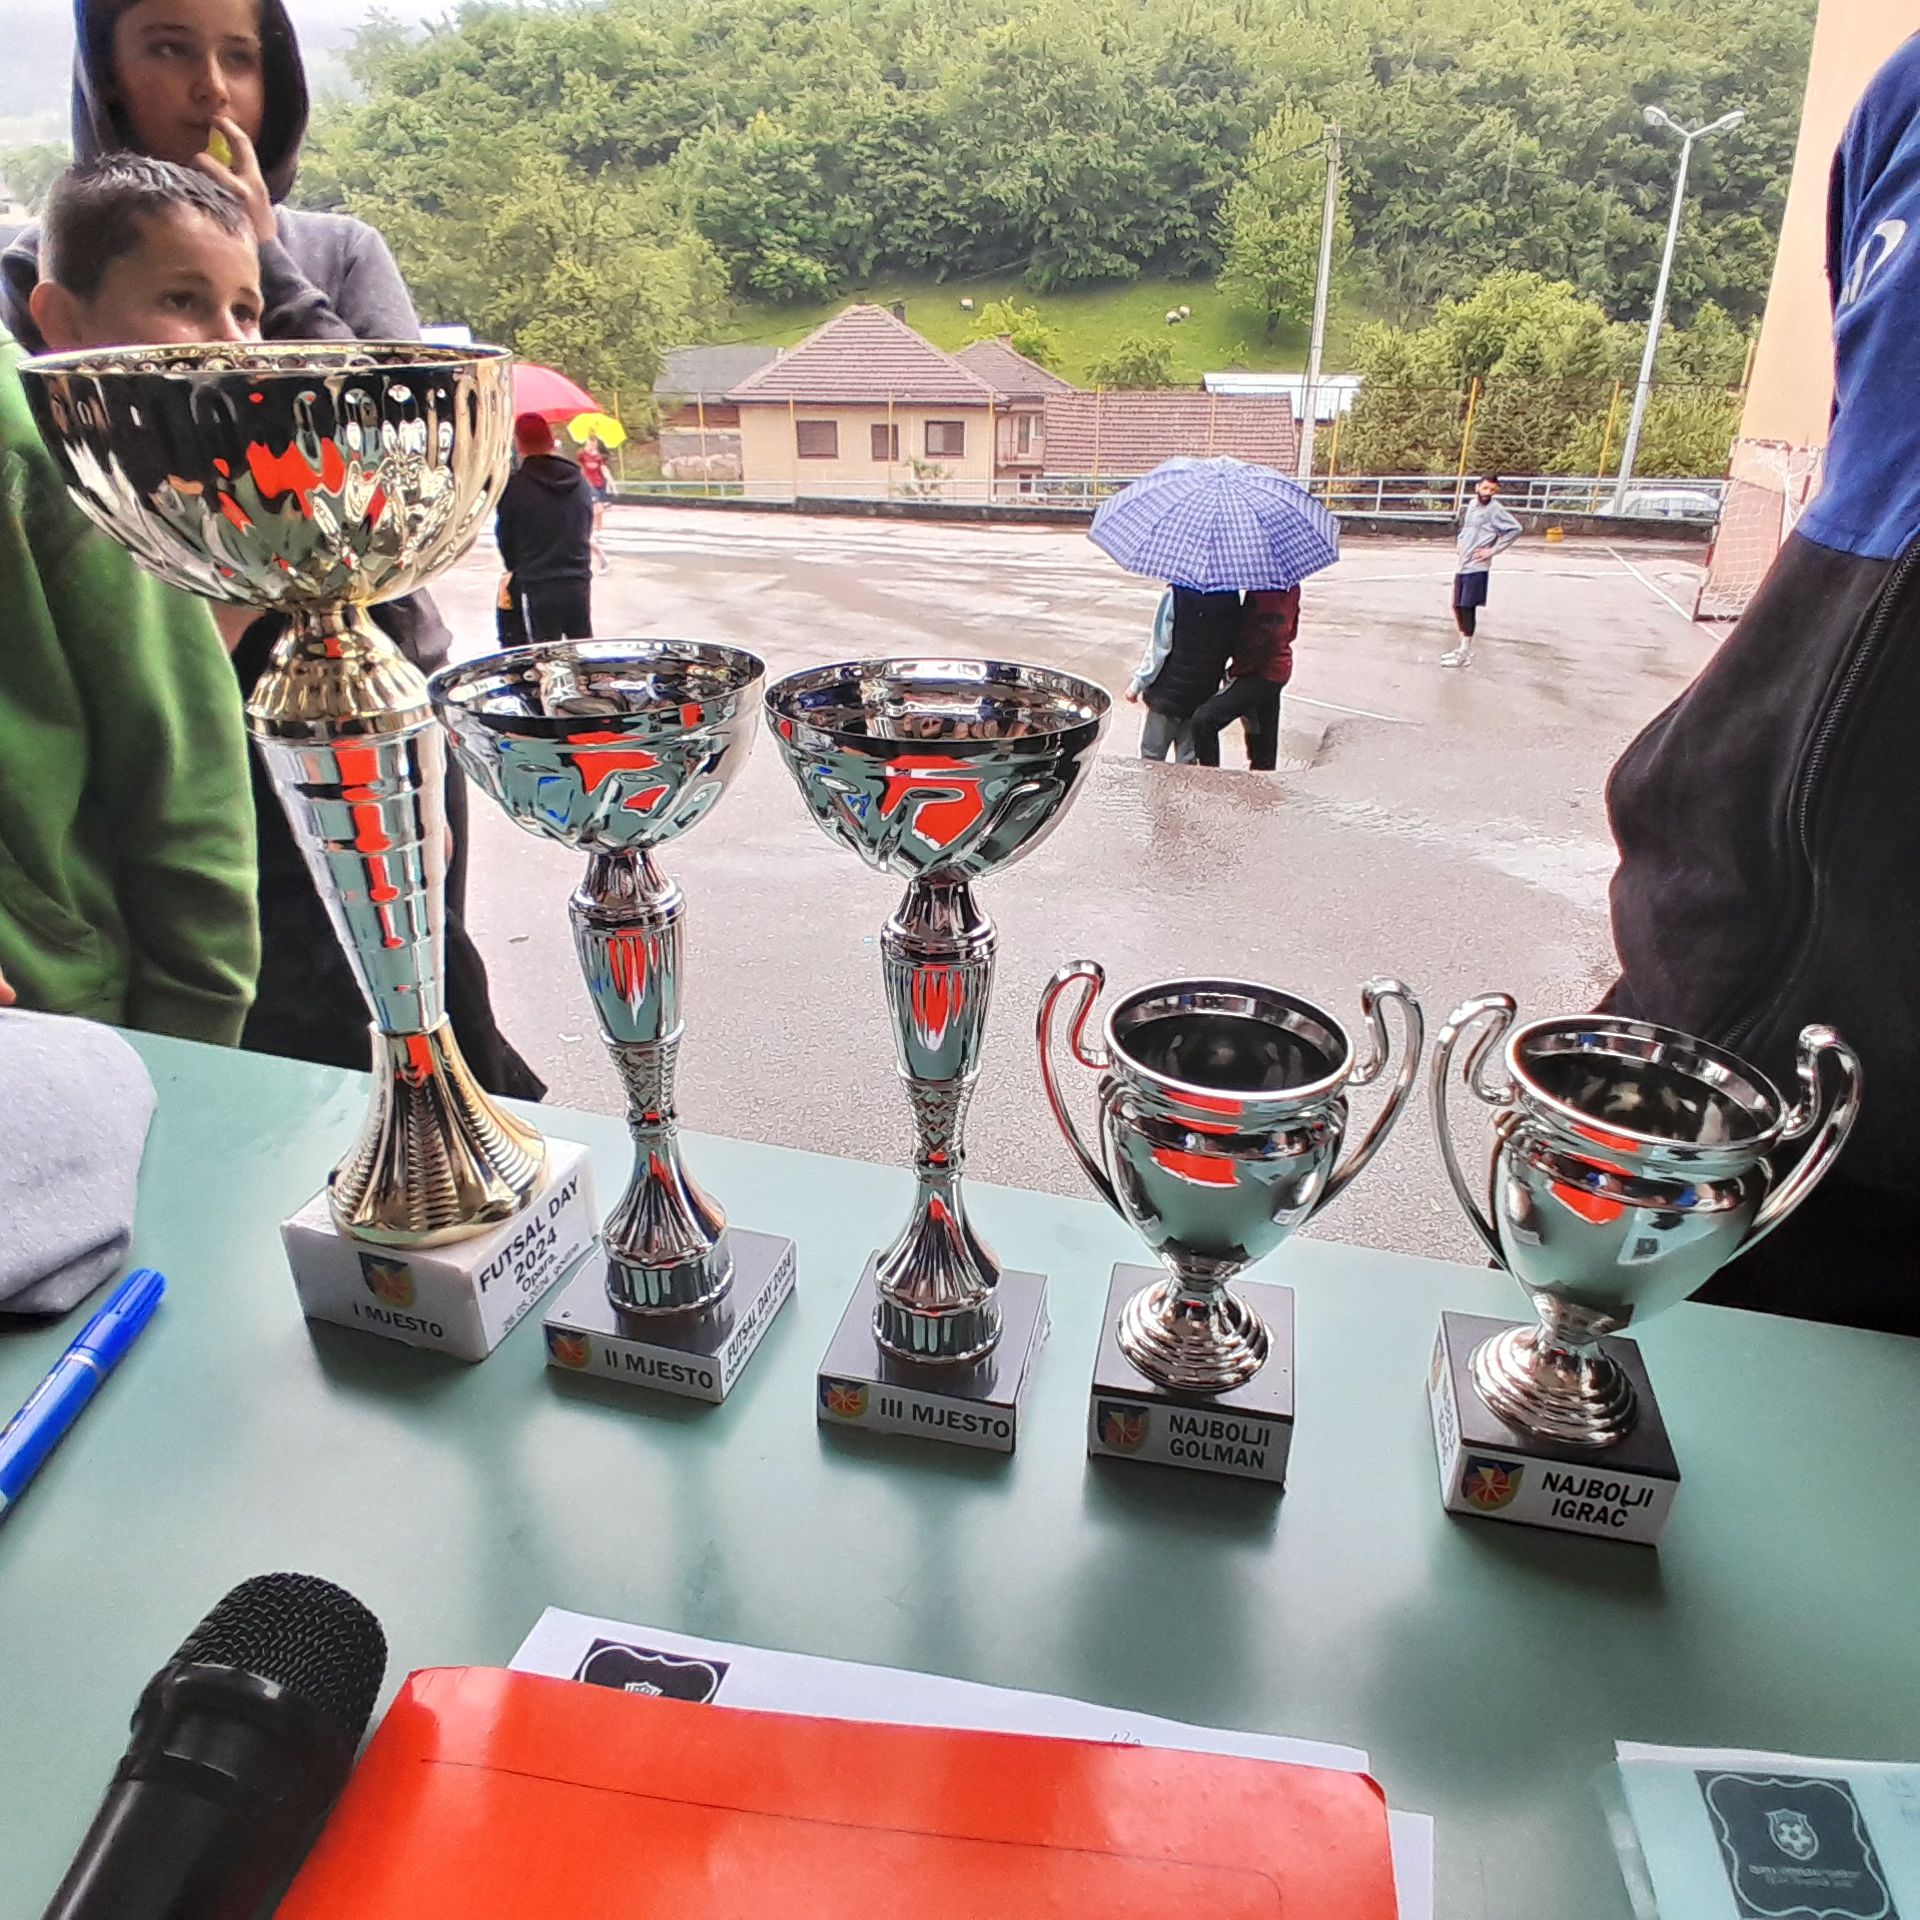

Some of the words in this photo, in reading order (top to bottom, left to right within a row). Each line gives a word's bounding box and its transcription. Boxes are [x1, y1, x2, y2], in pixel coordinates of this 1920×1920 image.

[479, 1215, 546, 1293] FUTSAL
[548, 1174, 578, 1219] DAY
[514, 1226, 557, 1284] 2024
[354, 1303, 360, 1316] I
[365, 1305, 443, 1338] MJESTO
[605, 1349, 618, 1368] II
[625, 1353, 713, 1389] MJESTO
[880, 1398, 903, 1418] III
[913, 1403, 1010, 1438] MJESTO
[1169, 1415, 1271, 1447] NAJBOLJI
[1170, 1438, 1265, 1469] GOLMAN
[1541, 1471, 1655, 1508] NAJBOLJI
[1551, 1499, 1628, 1528] IGRAČ
